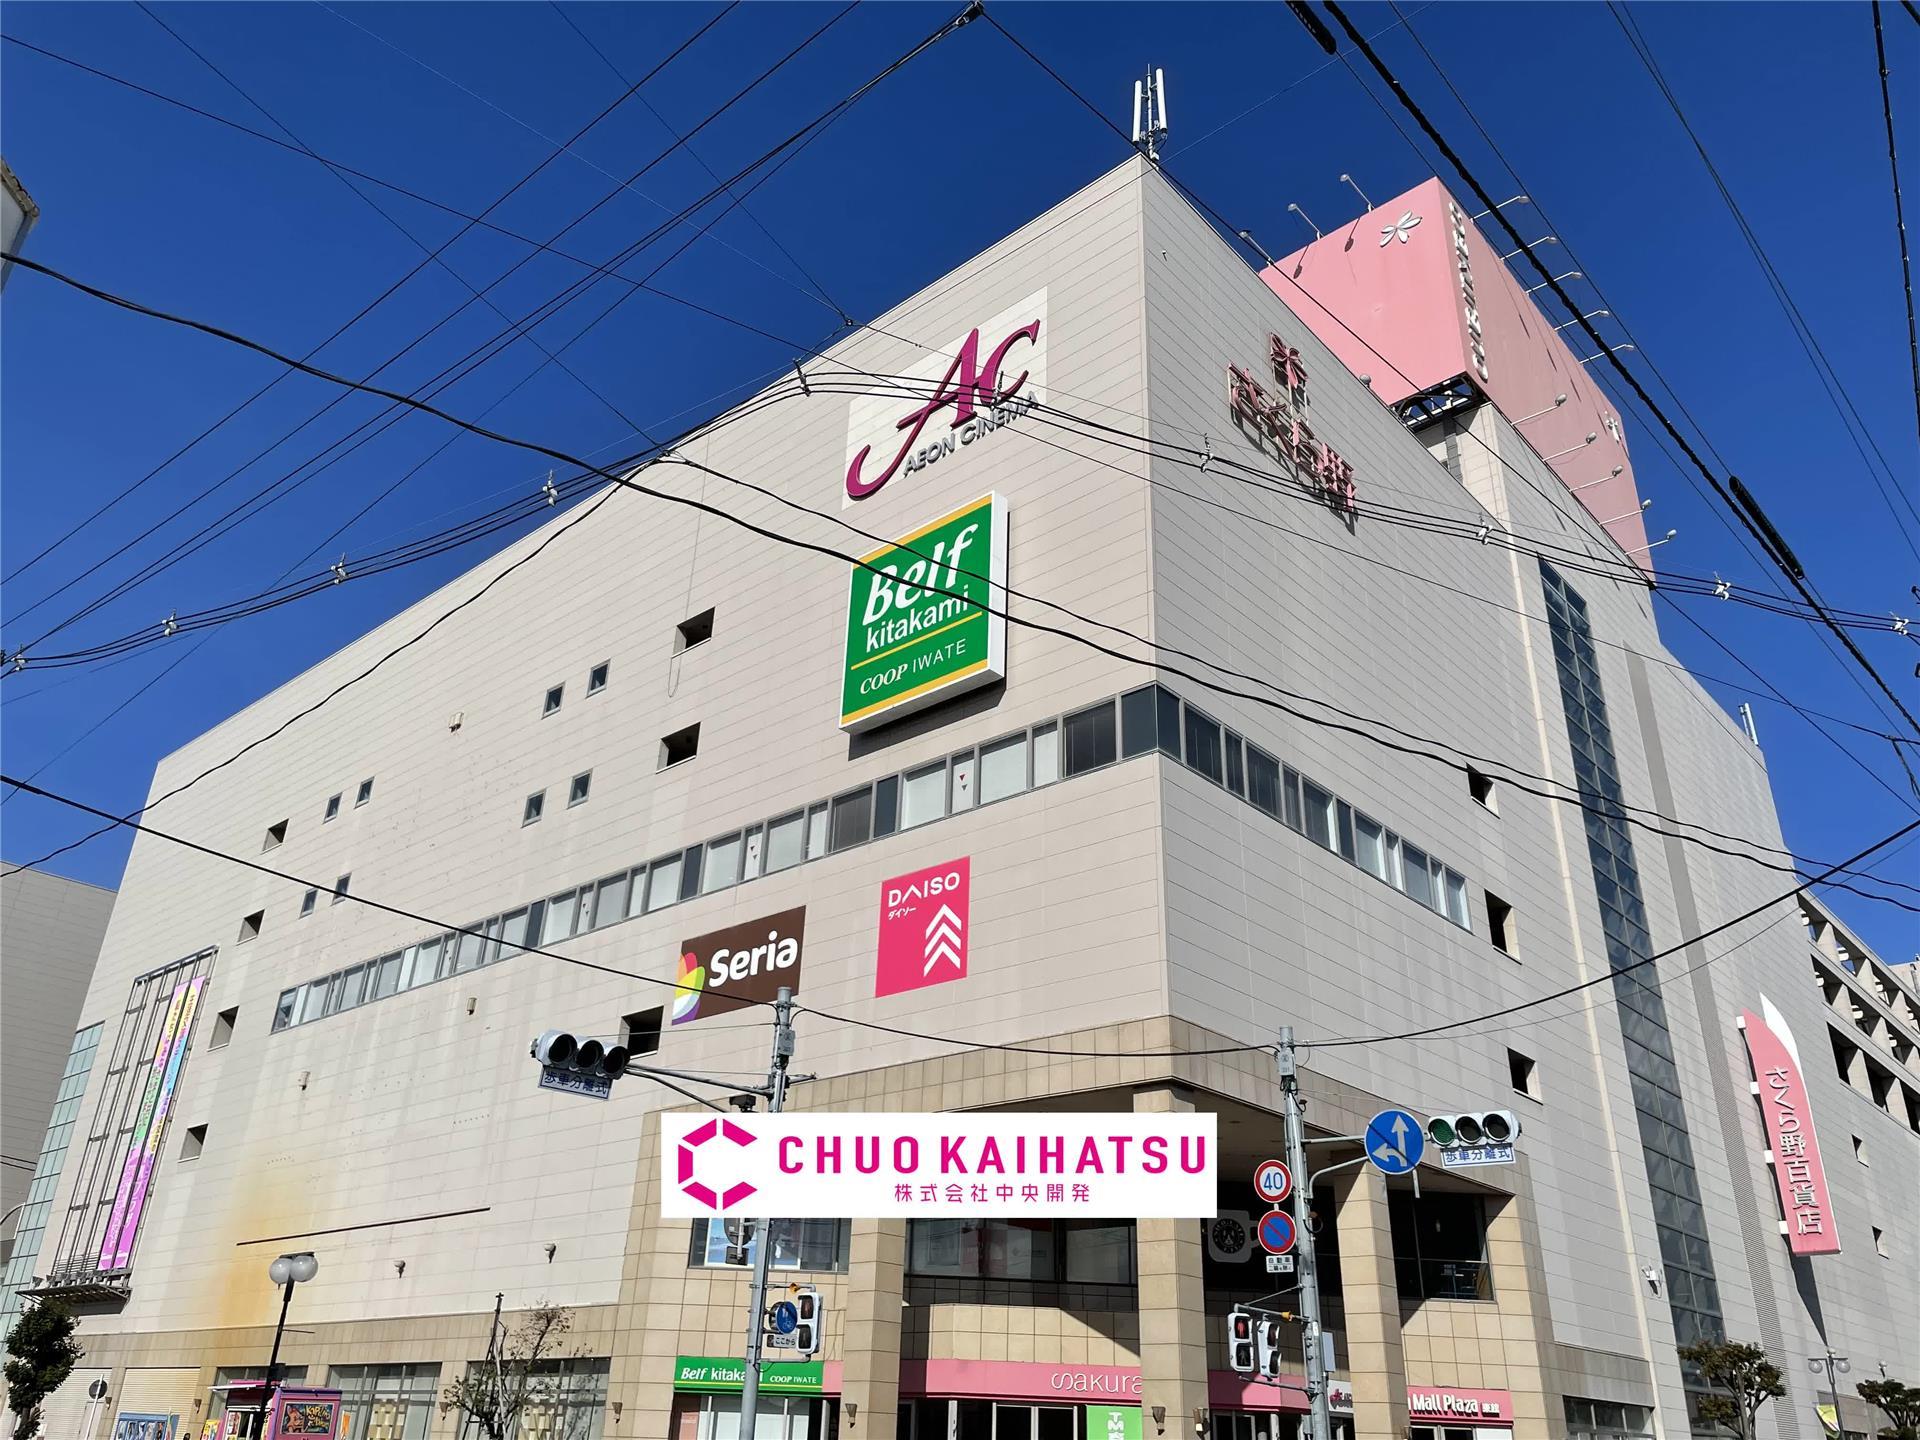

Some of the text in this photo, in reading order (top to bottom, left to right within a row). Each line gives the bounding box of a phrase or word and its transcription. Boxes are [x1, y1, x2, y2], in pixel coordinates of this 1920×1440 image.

[903, 390, 1039, 478] AEON CINEMA
[862, 523, 979, 626] Belf
[865, 584, 970, 653] kitakami
[859, 638, 967, 694] COOP IWATE
[887, 872, 960, 908] DAISO
[888, 906, 917, 921] ダイソー
[708, 930, 799, 988] Seria
[544, 1070, 609, 1095] 歩車分離式
[1445, 1146, 1511, 1162] 歩車分離式
[1765, 1066, 1824, 1236] さくら野百貨店
[1263, 1172, 1284, 1190] 40
[681, 1367, 817, 1384] Belf kitakai COOP IWATE
[1412, 1393, 1442, 1411] Mall
[1442, 1394, 1478, 1413] Plaza
